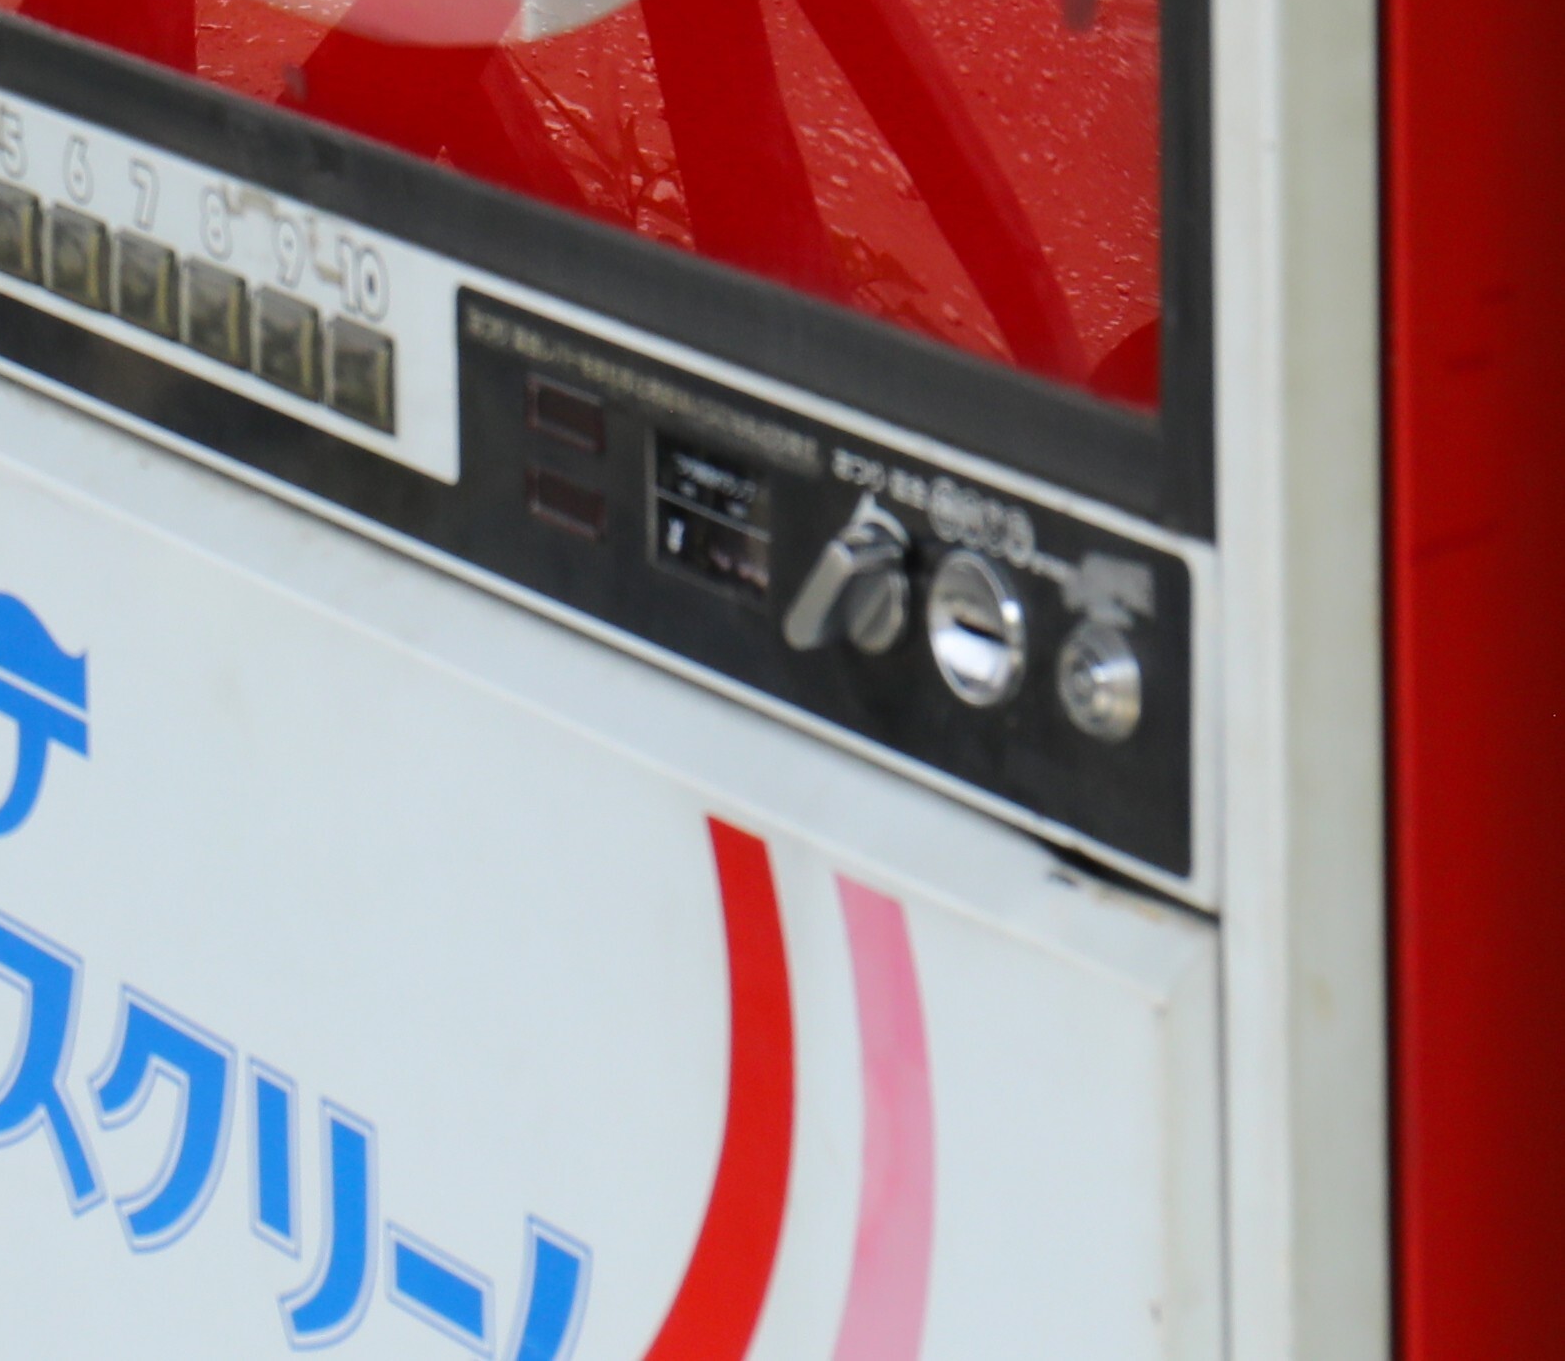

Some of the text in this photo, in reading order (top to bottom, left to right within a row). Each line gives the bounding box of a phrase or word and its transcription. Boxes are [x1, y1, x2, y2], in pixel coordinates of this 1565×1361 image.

[62, 133, 94, 206] 6
[127, 160, 160, 230] 7
[200, 184, 235, 260] 8
[273, 213, 307, 289] 9
[332, 238, 390, 324] 10
